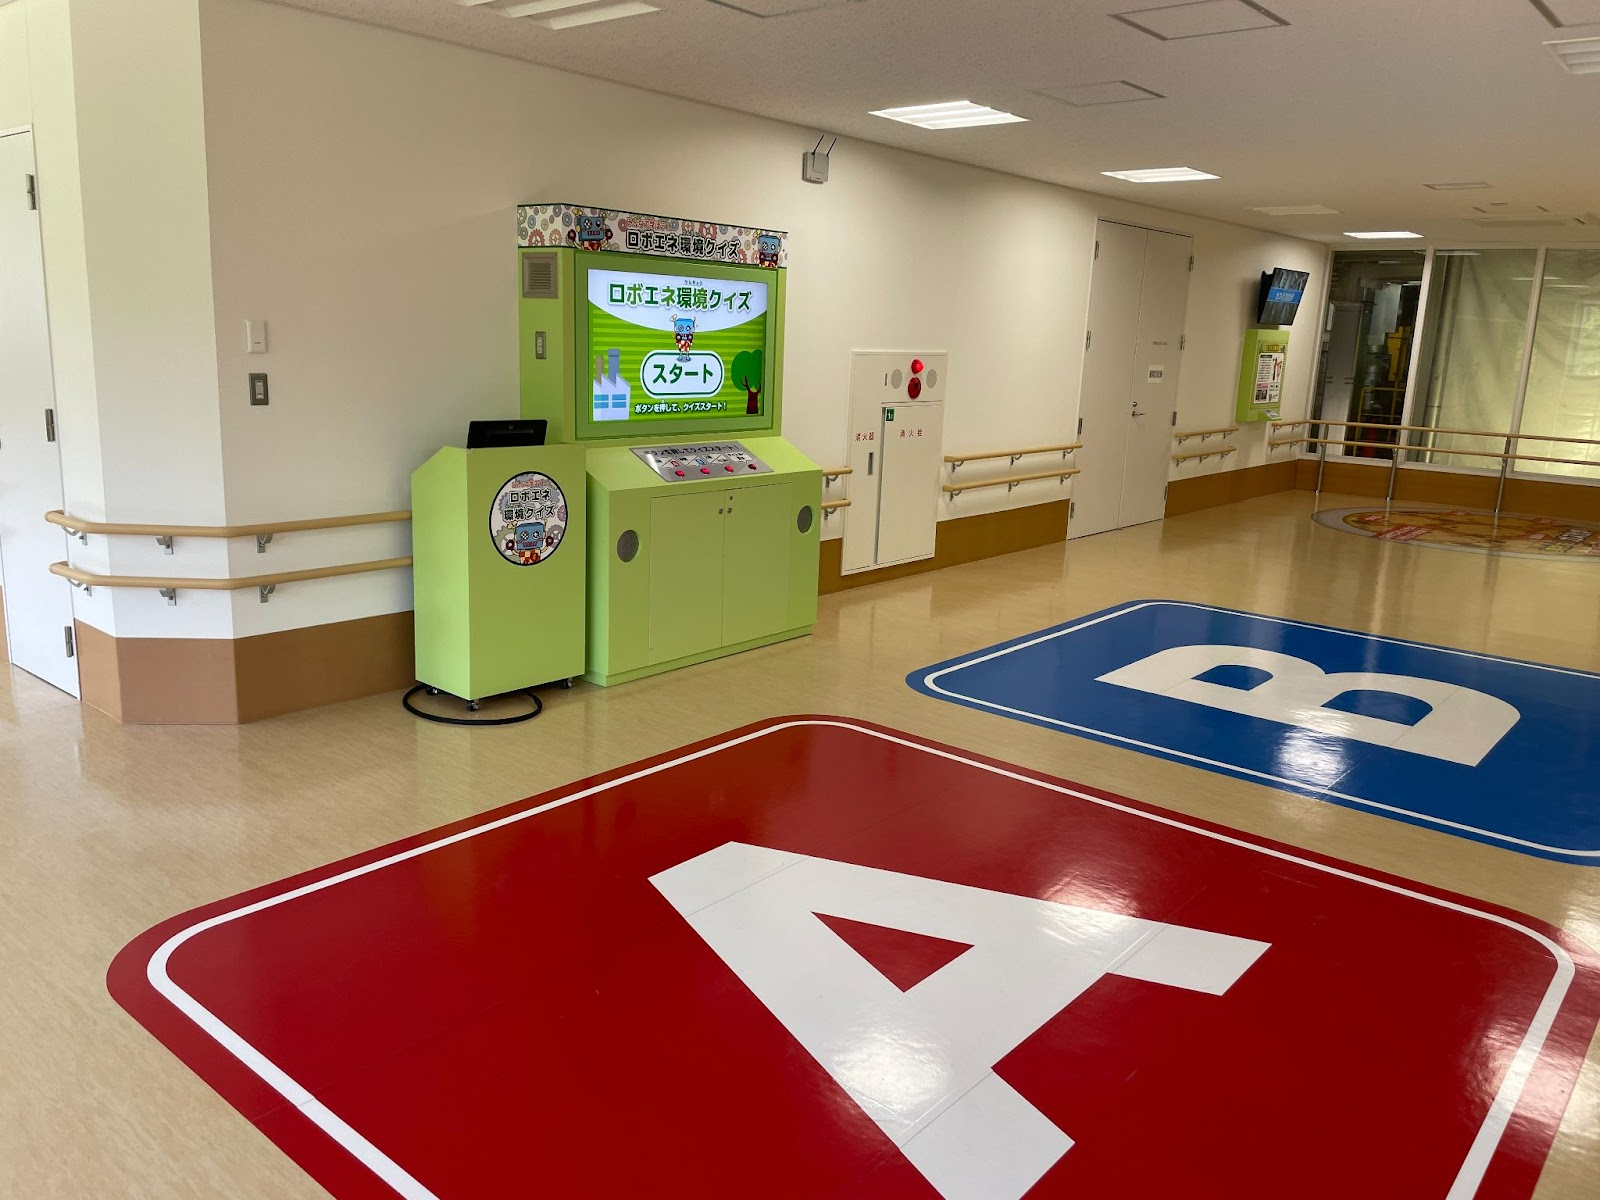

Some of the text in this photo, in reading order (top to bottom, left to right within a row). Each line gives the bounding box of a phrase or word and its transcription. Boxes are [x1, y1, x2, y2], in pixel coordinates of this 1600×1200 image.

[627, 230, 740, 258] ロボエネ環境クイズ
[609, 283, 752, 310] ロボエネ環境クイズ
[653, 363, 713, 384] スタート
[855, 432, 874, 441] 消火器
[900, 428, 923, 438] 消火栓
[510, 488, 551, 503] ロボエネ
[504, 504, 556, 521] 環境クイズ
[1094, 645, 1521, 767] B
[648, 841, 1272, 1200] A
